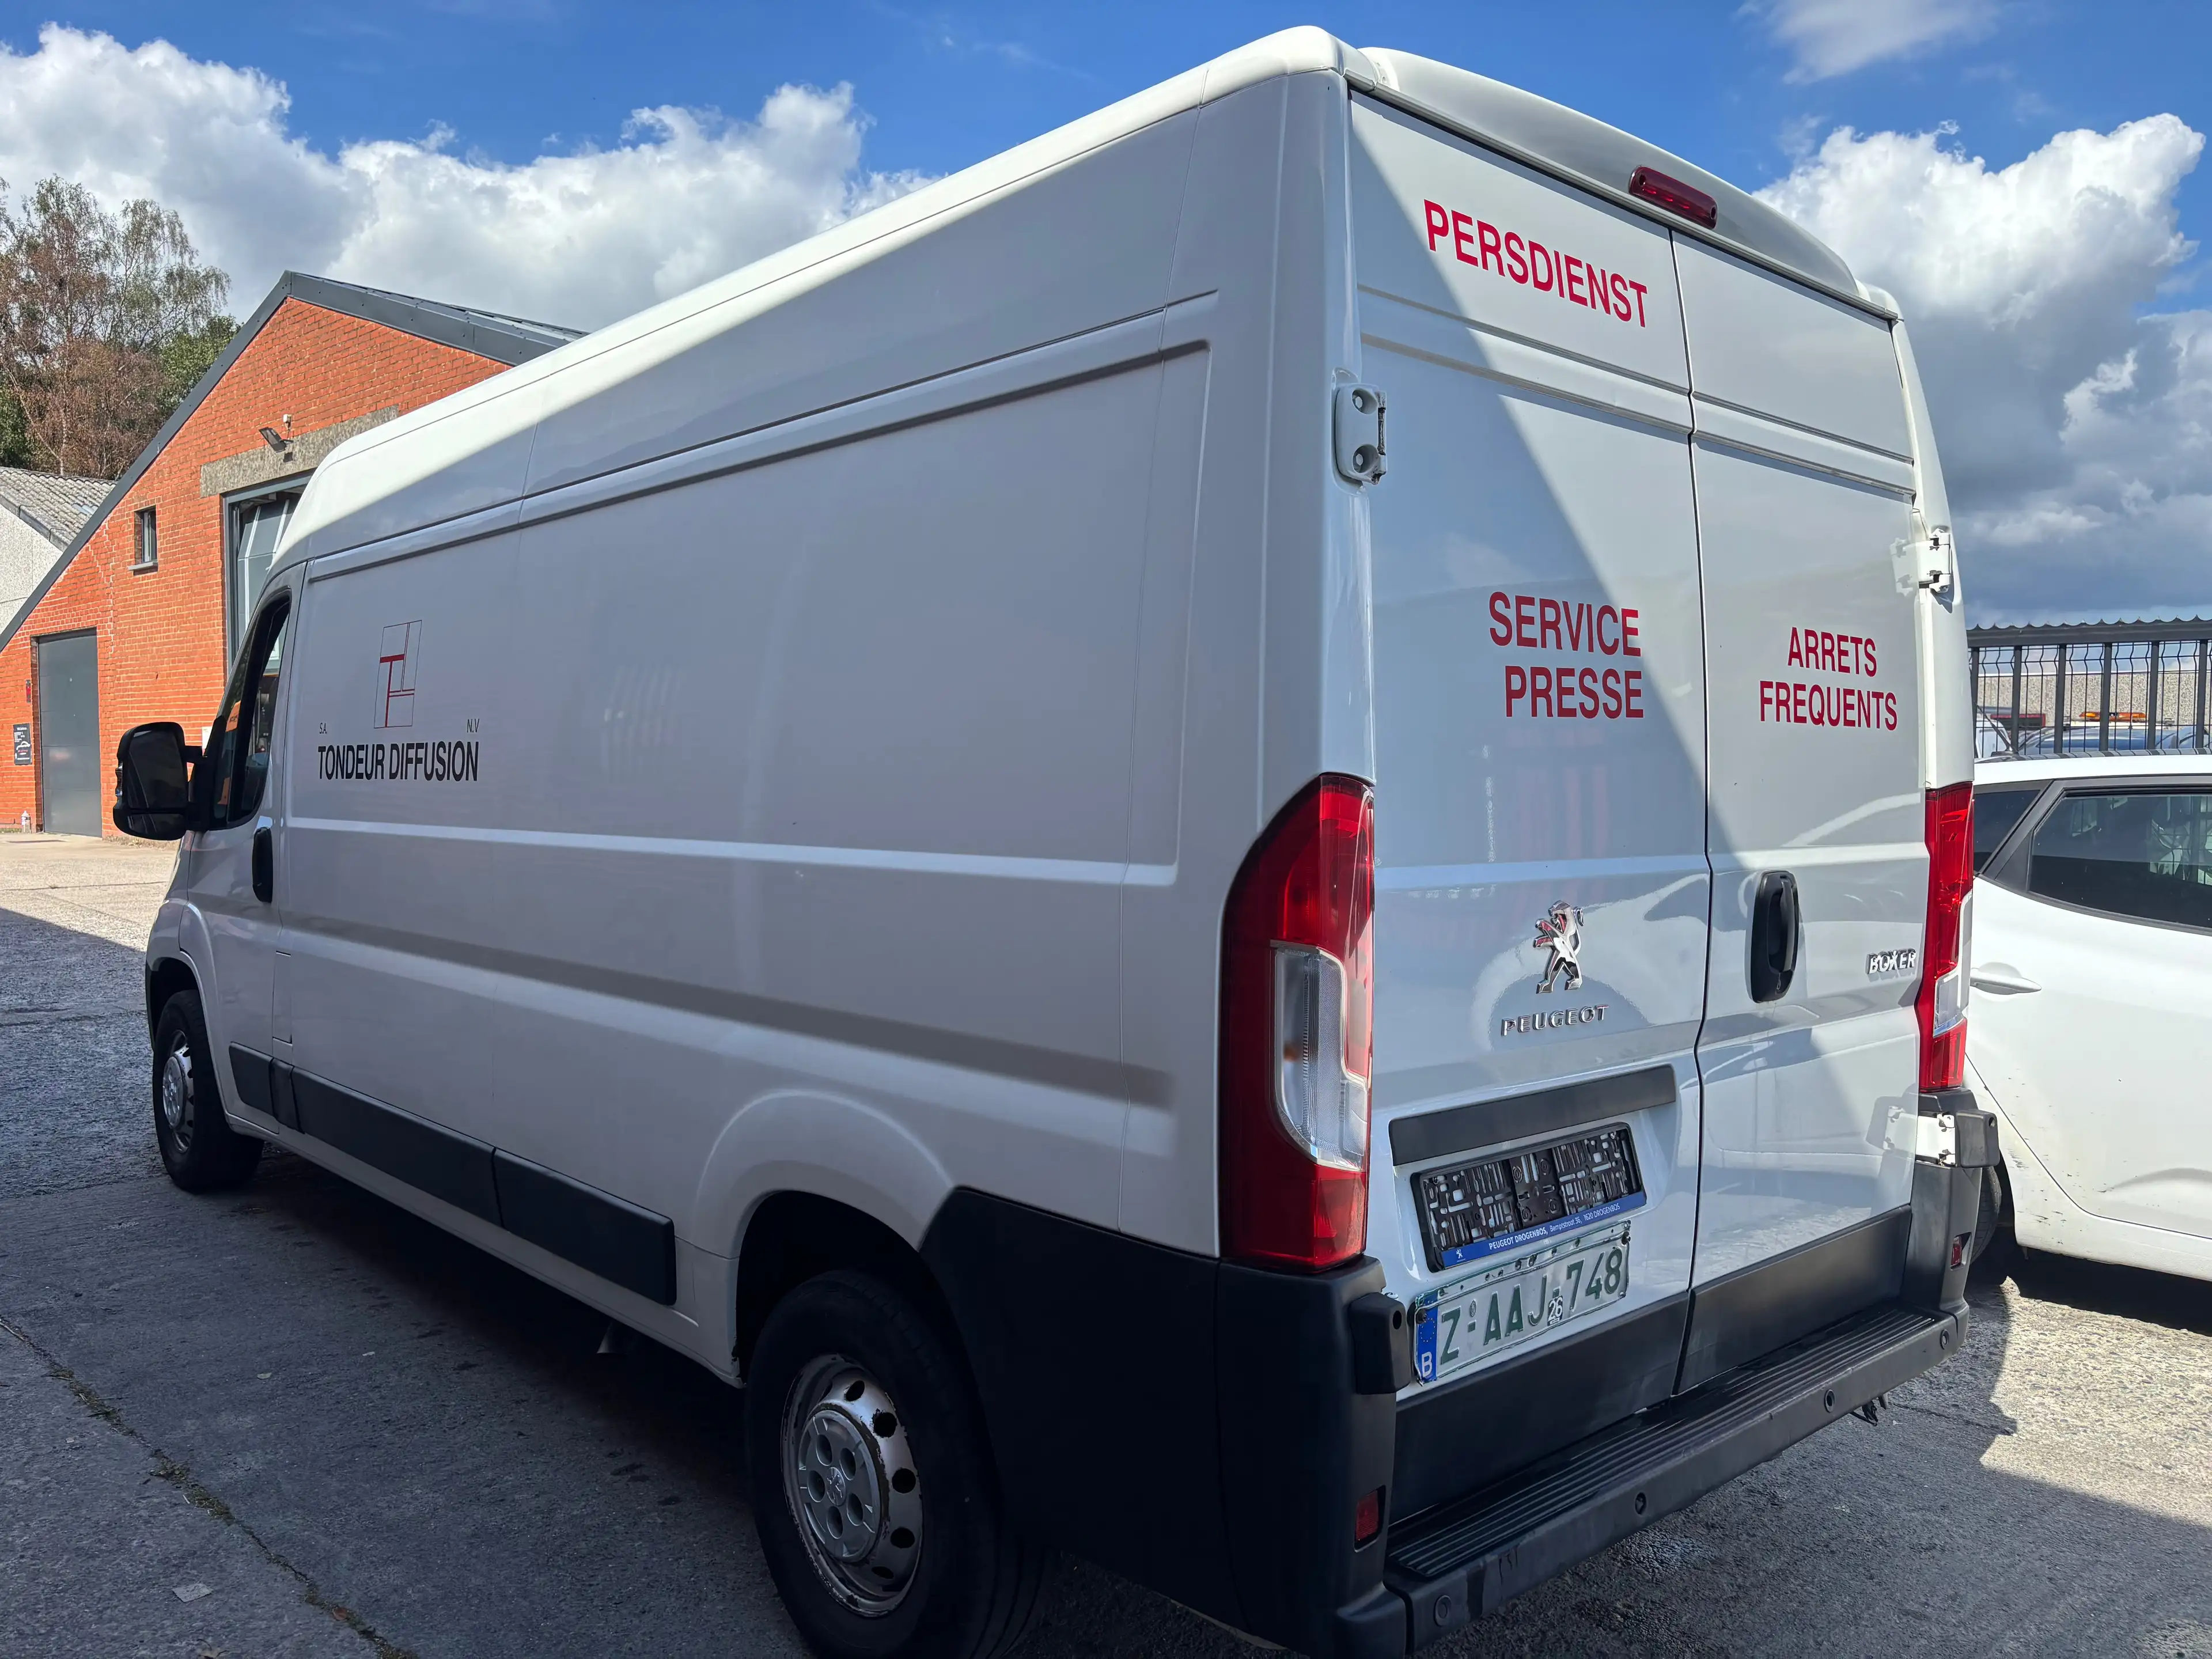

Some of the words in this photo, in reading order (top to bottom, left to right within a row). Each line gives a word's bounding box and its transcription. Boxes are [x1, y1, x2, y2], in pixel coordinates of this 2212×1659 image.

[1424, 199, 1647, 328] PERSDIENST
[1489, 591, 1641, 657] SERVICE
[1787, 627, 1877, 677] ARRETS
[1505, 665, 1643, 719] PRESSE
[1760, 680, 1897, 730] FREQUENTS
[318, 744, 385, 780] TONDEUR
[389, 741, 479, 781] DIFFUSION
[1866, 948, 1916, 975] BOXER
[1501, 1003, 1609, 1036] PEUGEOT
[1488, 1236, 1514, 1250] PEUGEOT
[1548, 1296, 1563, 1321] 26
[1422, 1351, 1432, 1377] B
